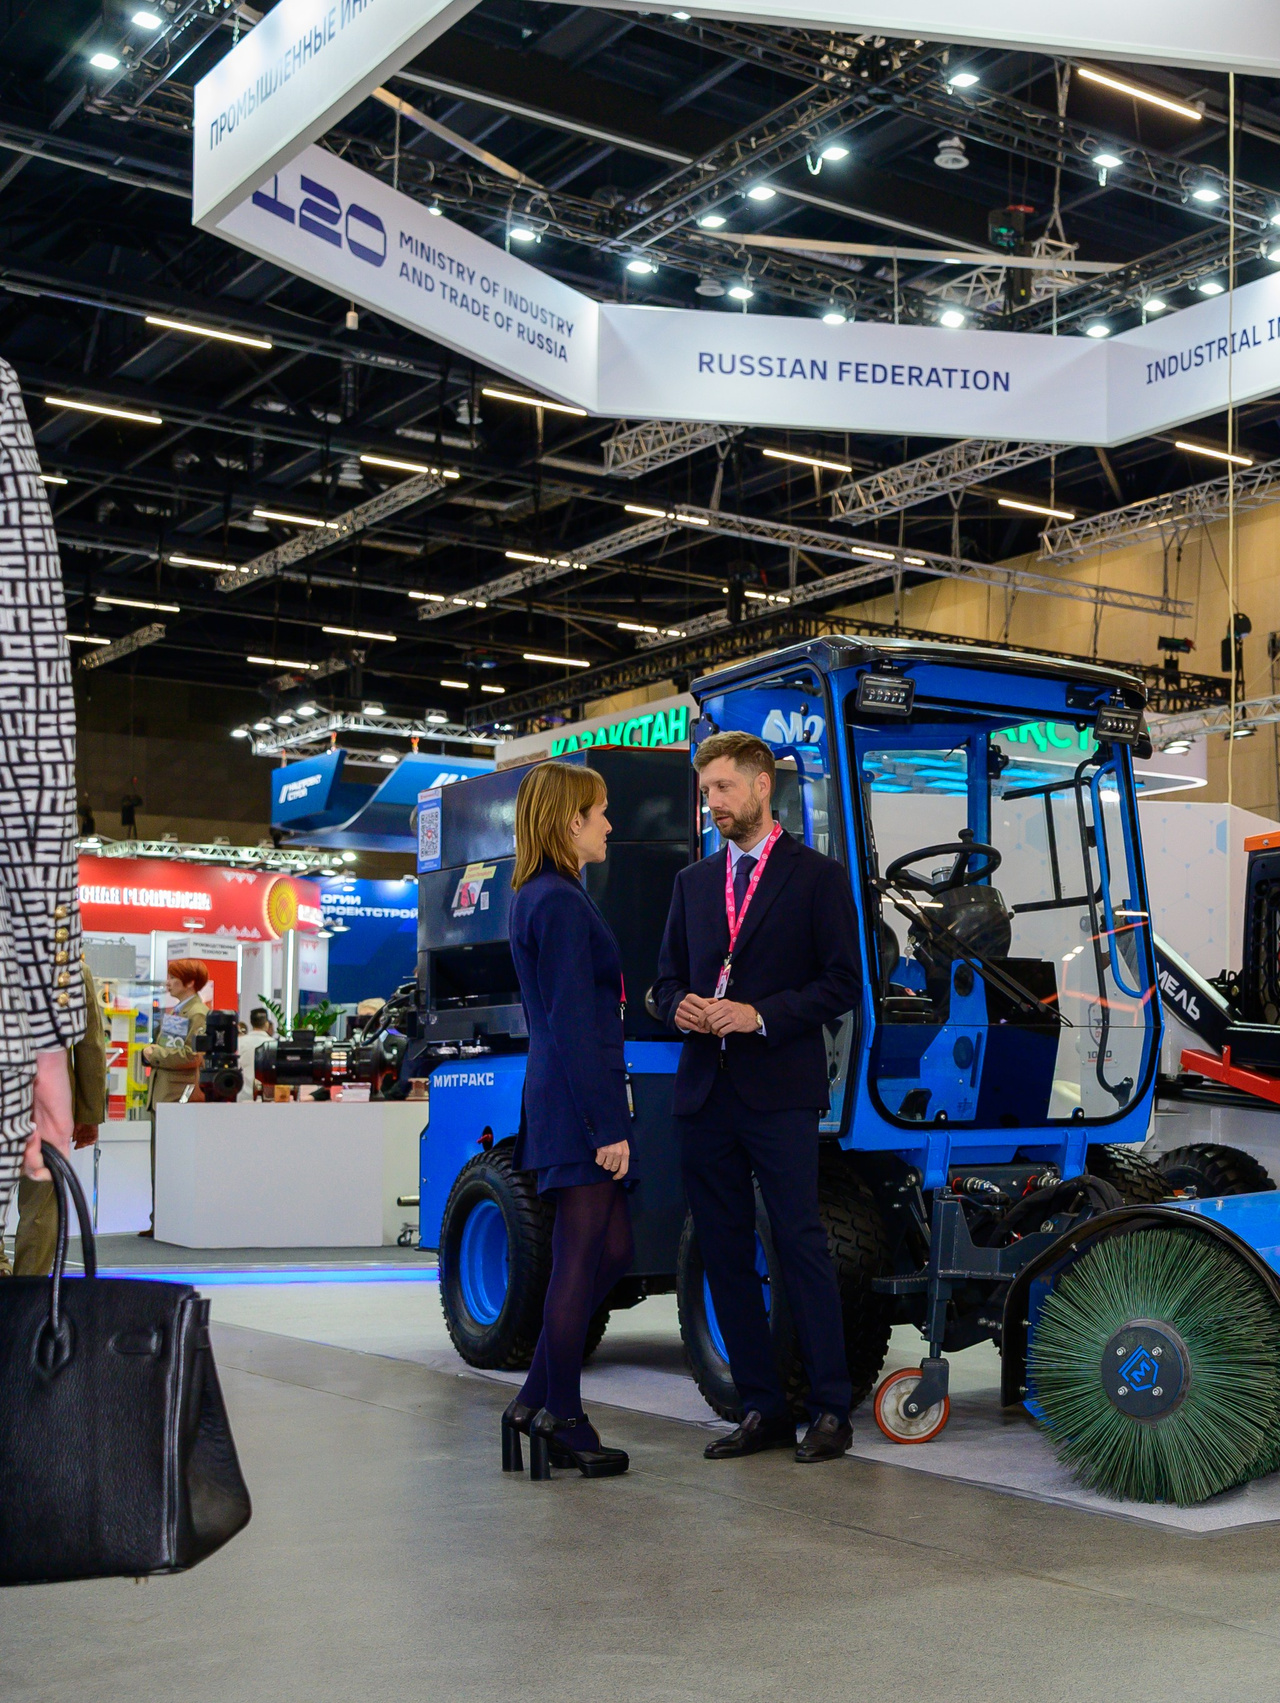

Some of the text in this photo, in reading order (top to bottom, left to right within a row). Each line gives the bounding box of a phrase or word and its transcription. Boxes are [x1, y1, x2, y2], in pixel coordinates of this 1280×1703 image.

[209, 7, 336, 150] ПРОМЫШЛЕННЫЕ
[399, 262, 568, 362] AND TRADE OF RUSSIA
[400, 231, 573, 338] MINISTRY OF INDUSTRY
[699, 352, 1011, 392] RUSSIAN FEDERATION
[1146, 325, 1262, 384] INDUSTRIAL
[1156, 961, 1200, 1021] МЕЛЬ
[433, 1072, 494, 1088] МИТРАКС
